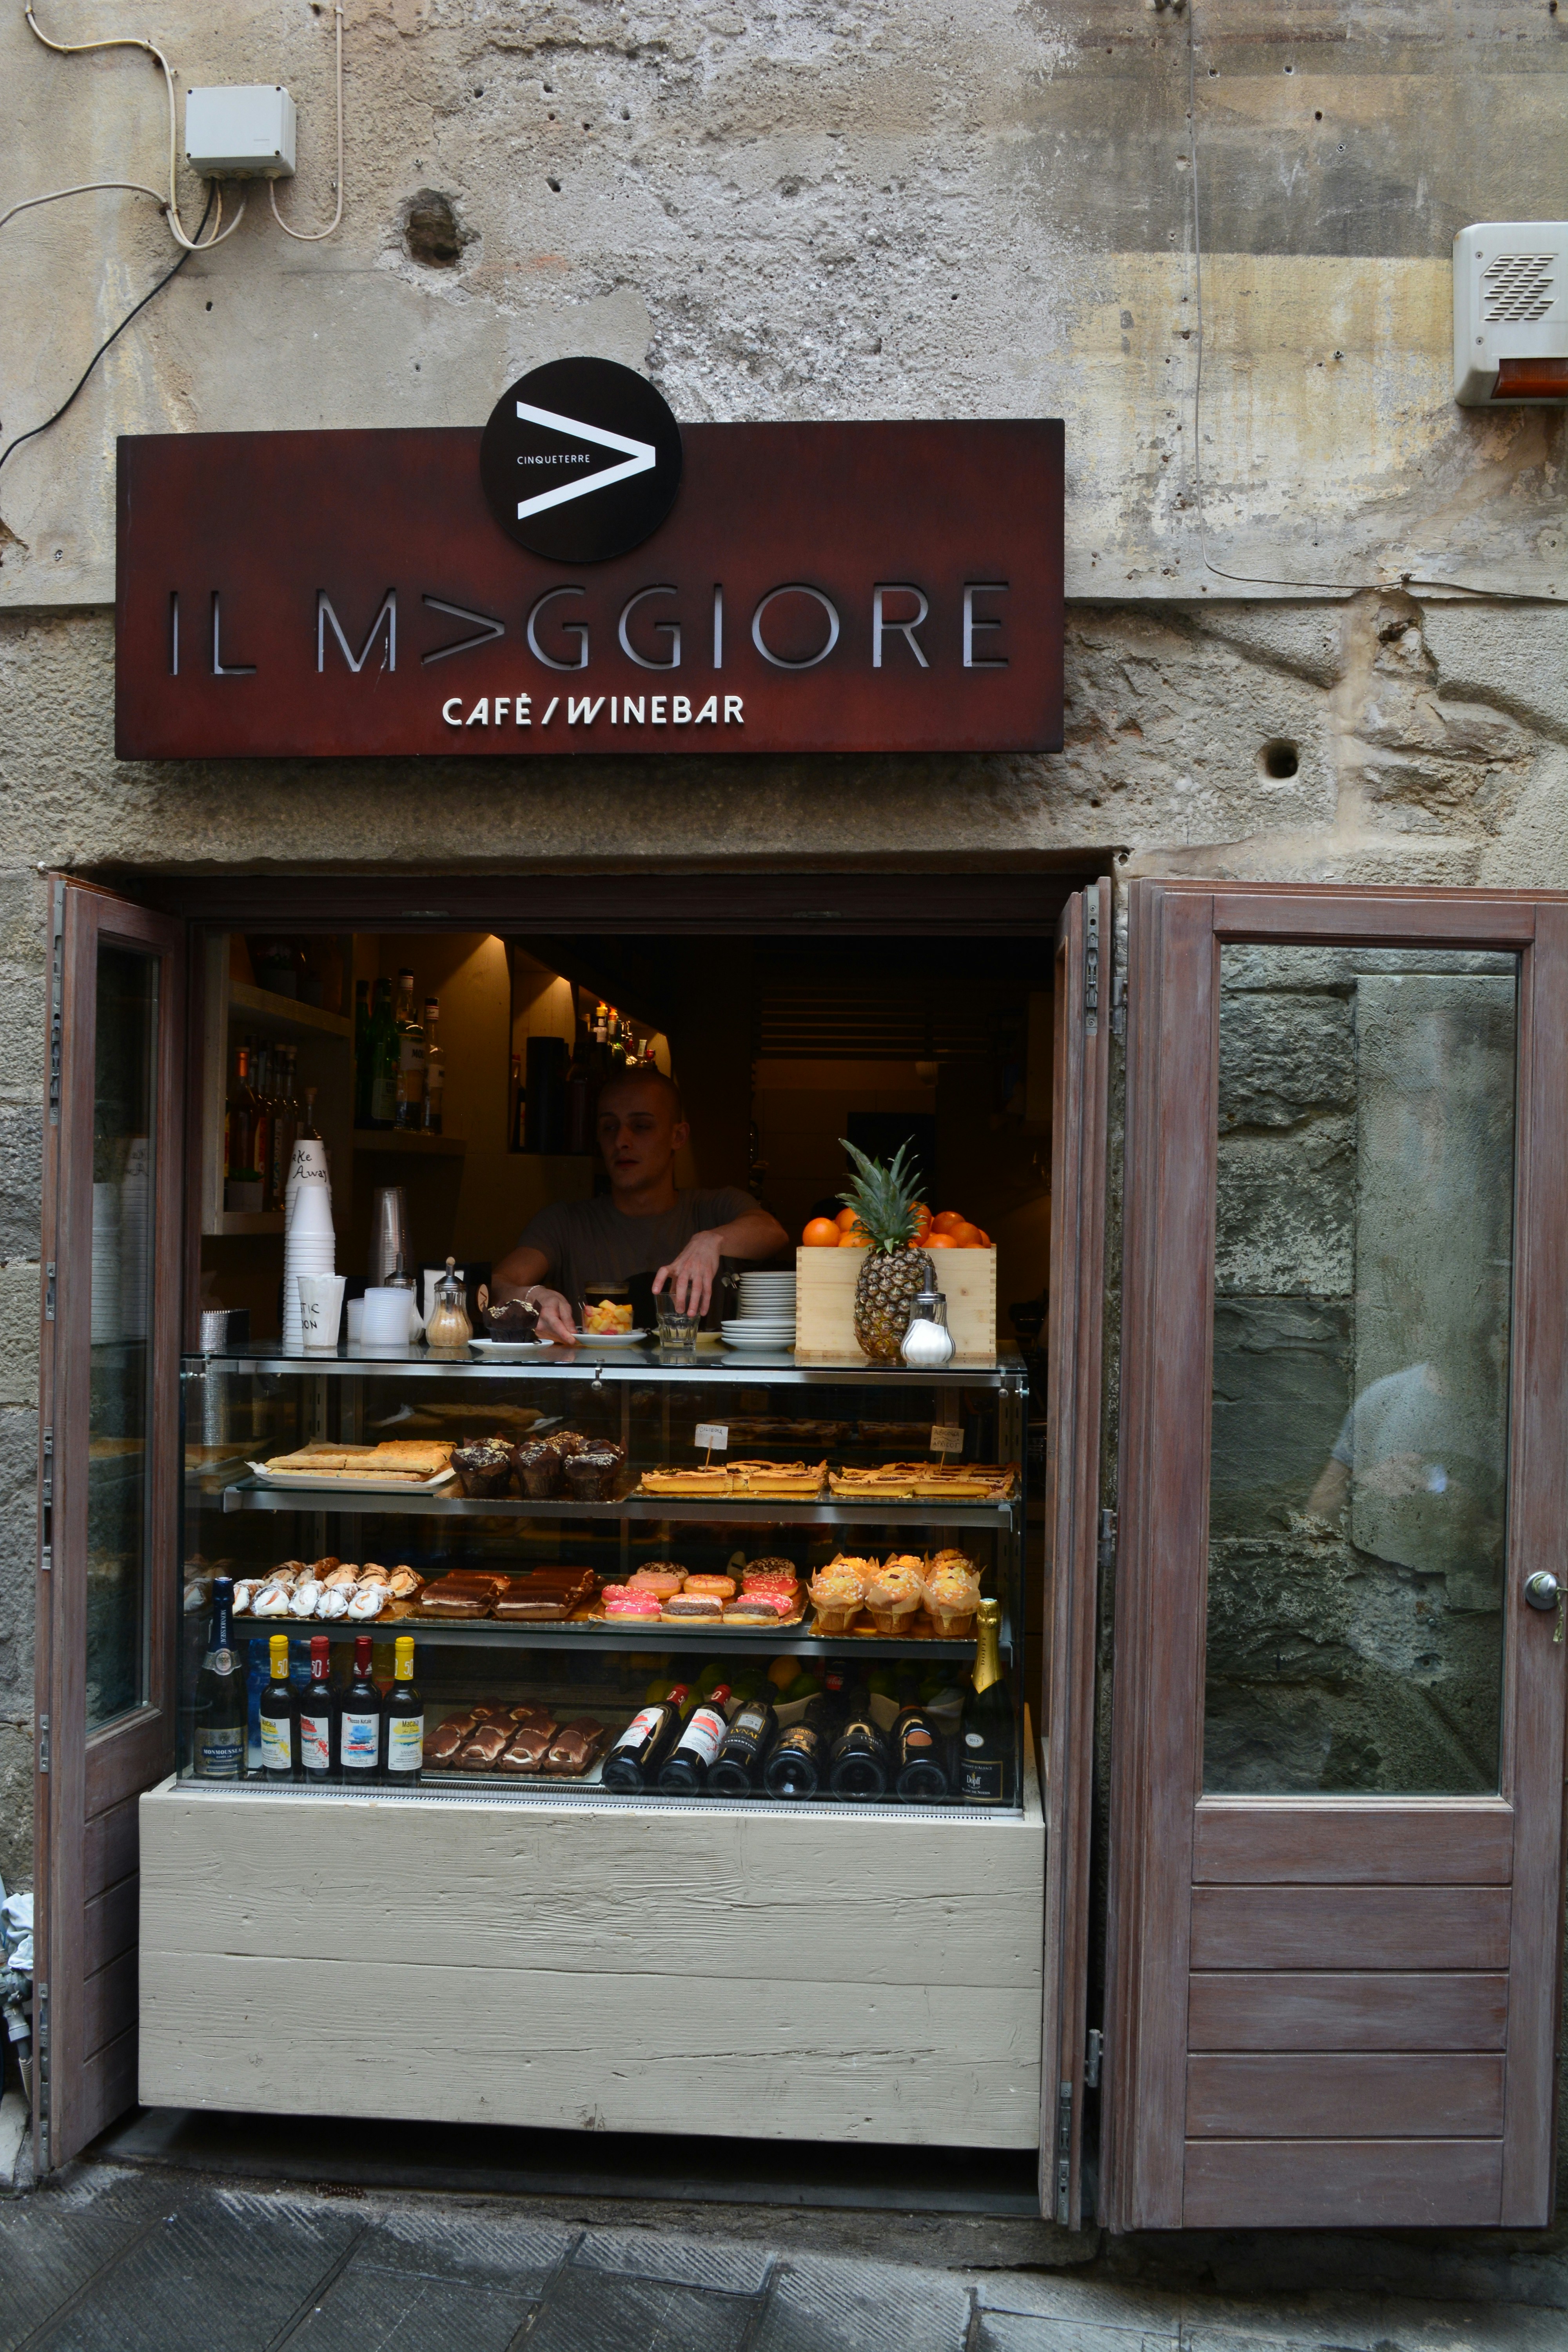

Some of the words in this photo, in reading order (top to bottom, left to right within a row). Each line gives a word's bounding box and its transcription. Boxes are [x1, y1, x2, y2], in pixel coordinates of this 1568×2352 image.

[517, 454, 590, 465] CINQUETERRE
[170, 590, 257, 675] IL
[292, 1165, 327, 1183] Away
[277, 1658, 288, 1676] 50
[312, 1659, 322, 1677] 50
[402, 1719, 419, 1728] Macaia
[706, 1713, 722, 1726] Macaia
[724, 1739, 757, 1751] VERMENTINO
[967, 1775, 982, 1787] Dopff
